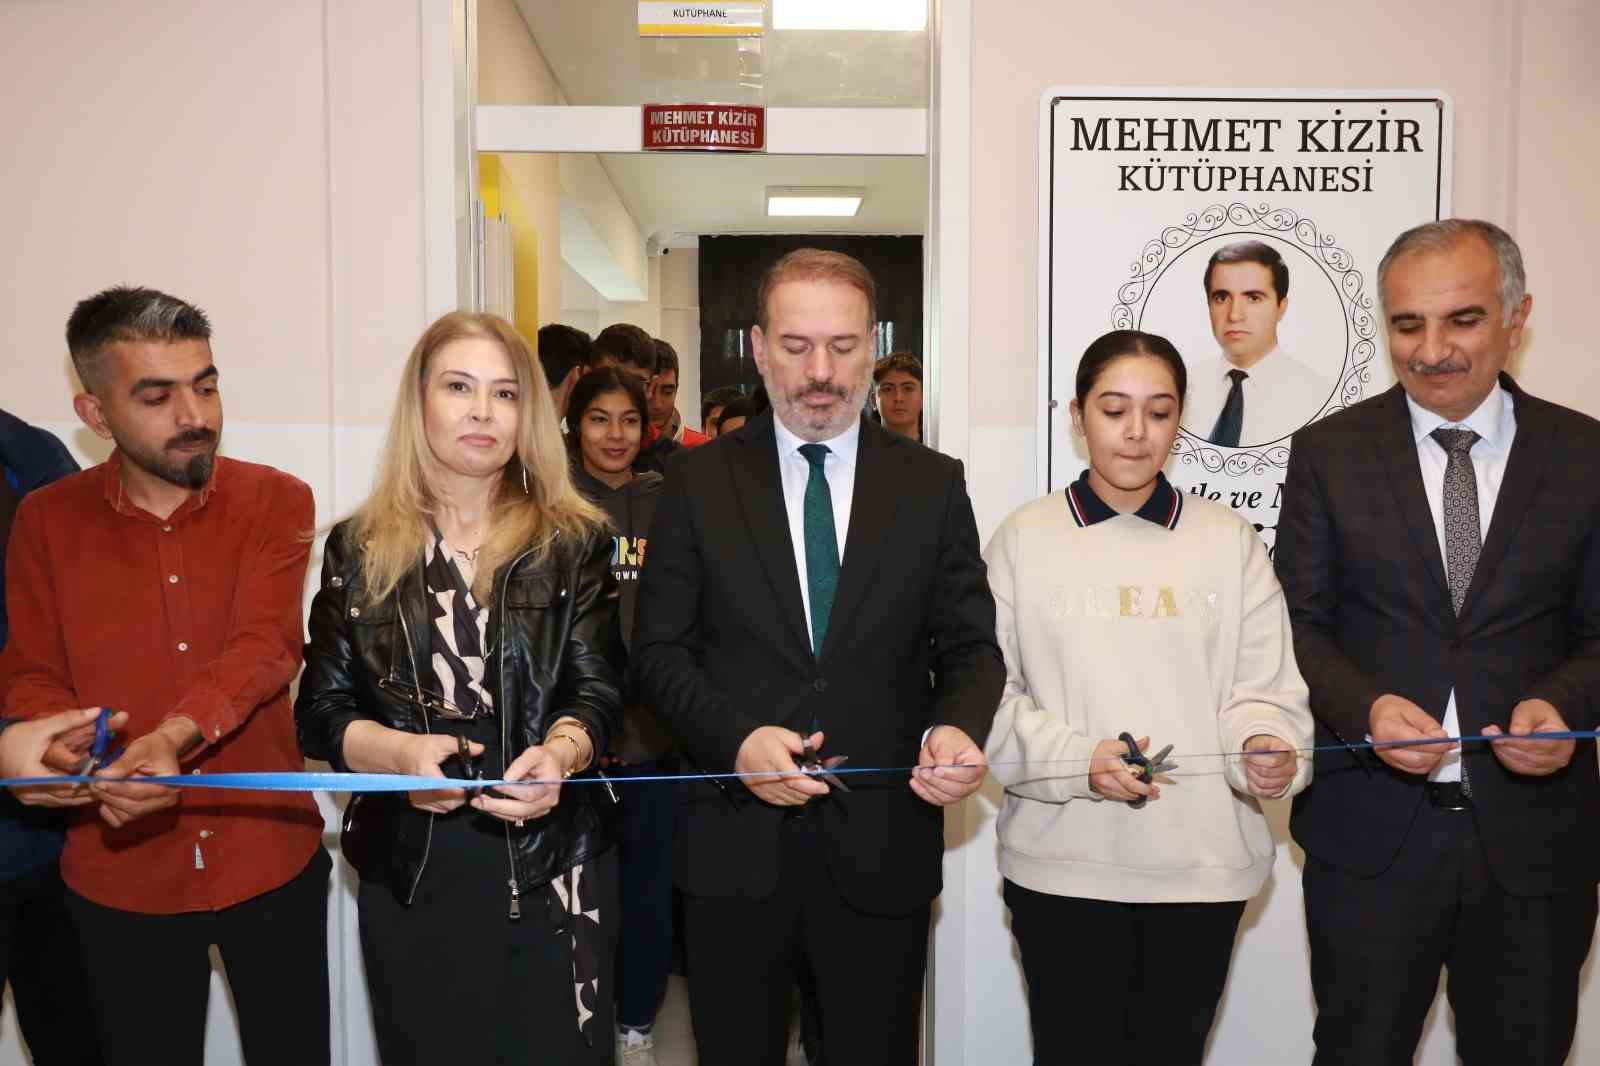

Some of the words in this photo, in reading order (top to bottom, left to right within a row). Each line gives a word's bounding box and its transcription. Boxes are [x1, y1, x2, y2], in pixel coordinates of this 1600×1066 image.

[673, 8, 728, 18] KÜTÜPHANE
[650, 111, 714, 125] MEHMET
[718, 109, 757, 126] KİZİR
[652, 127, 755, 144] KÜTÜPHANESİ
[1069, 118, 1281, 152] MEHMET
[1297, 109, 1424, 153] KİZİR
[1117, 158, 1374, 192] KÜTÜPHANESİ
[1230, 490, 1262, 509] ve
